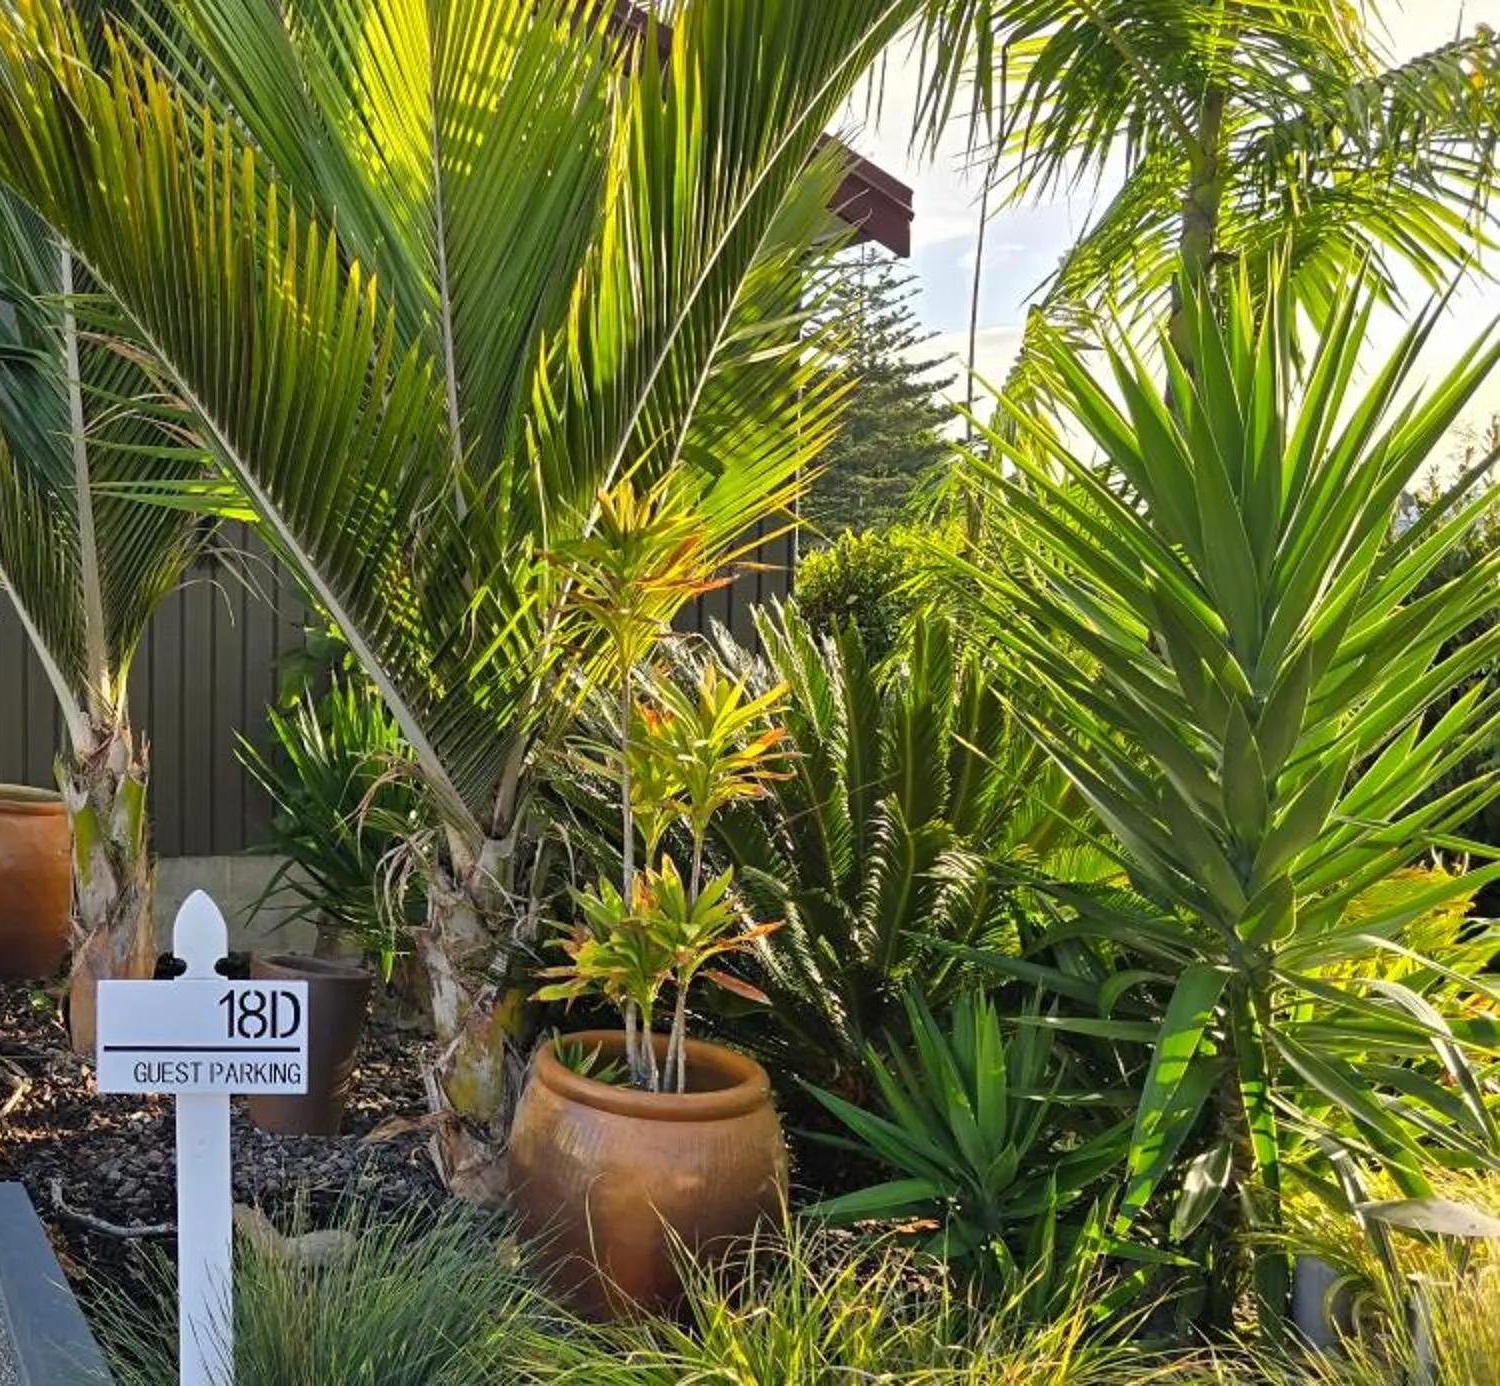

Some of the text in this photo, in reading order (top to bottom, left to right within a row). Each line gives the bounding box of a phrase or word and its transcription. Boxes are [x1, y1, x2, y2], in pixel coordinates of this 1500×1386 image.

[219, 989, 301, 1039] 18D
[133, 1061, 301, 1085] GUEST PARKING
